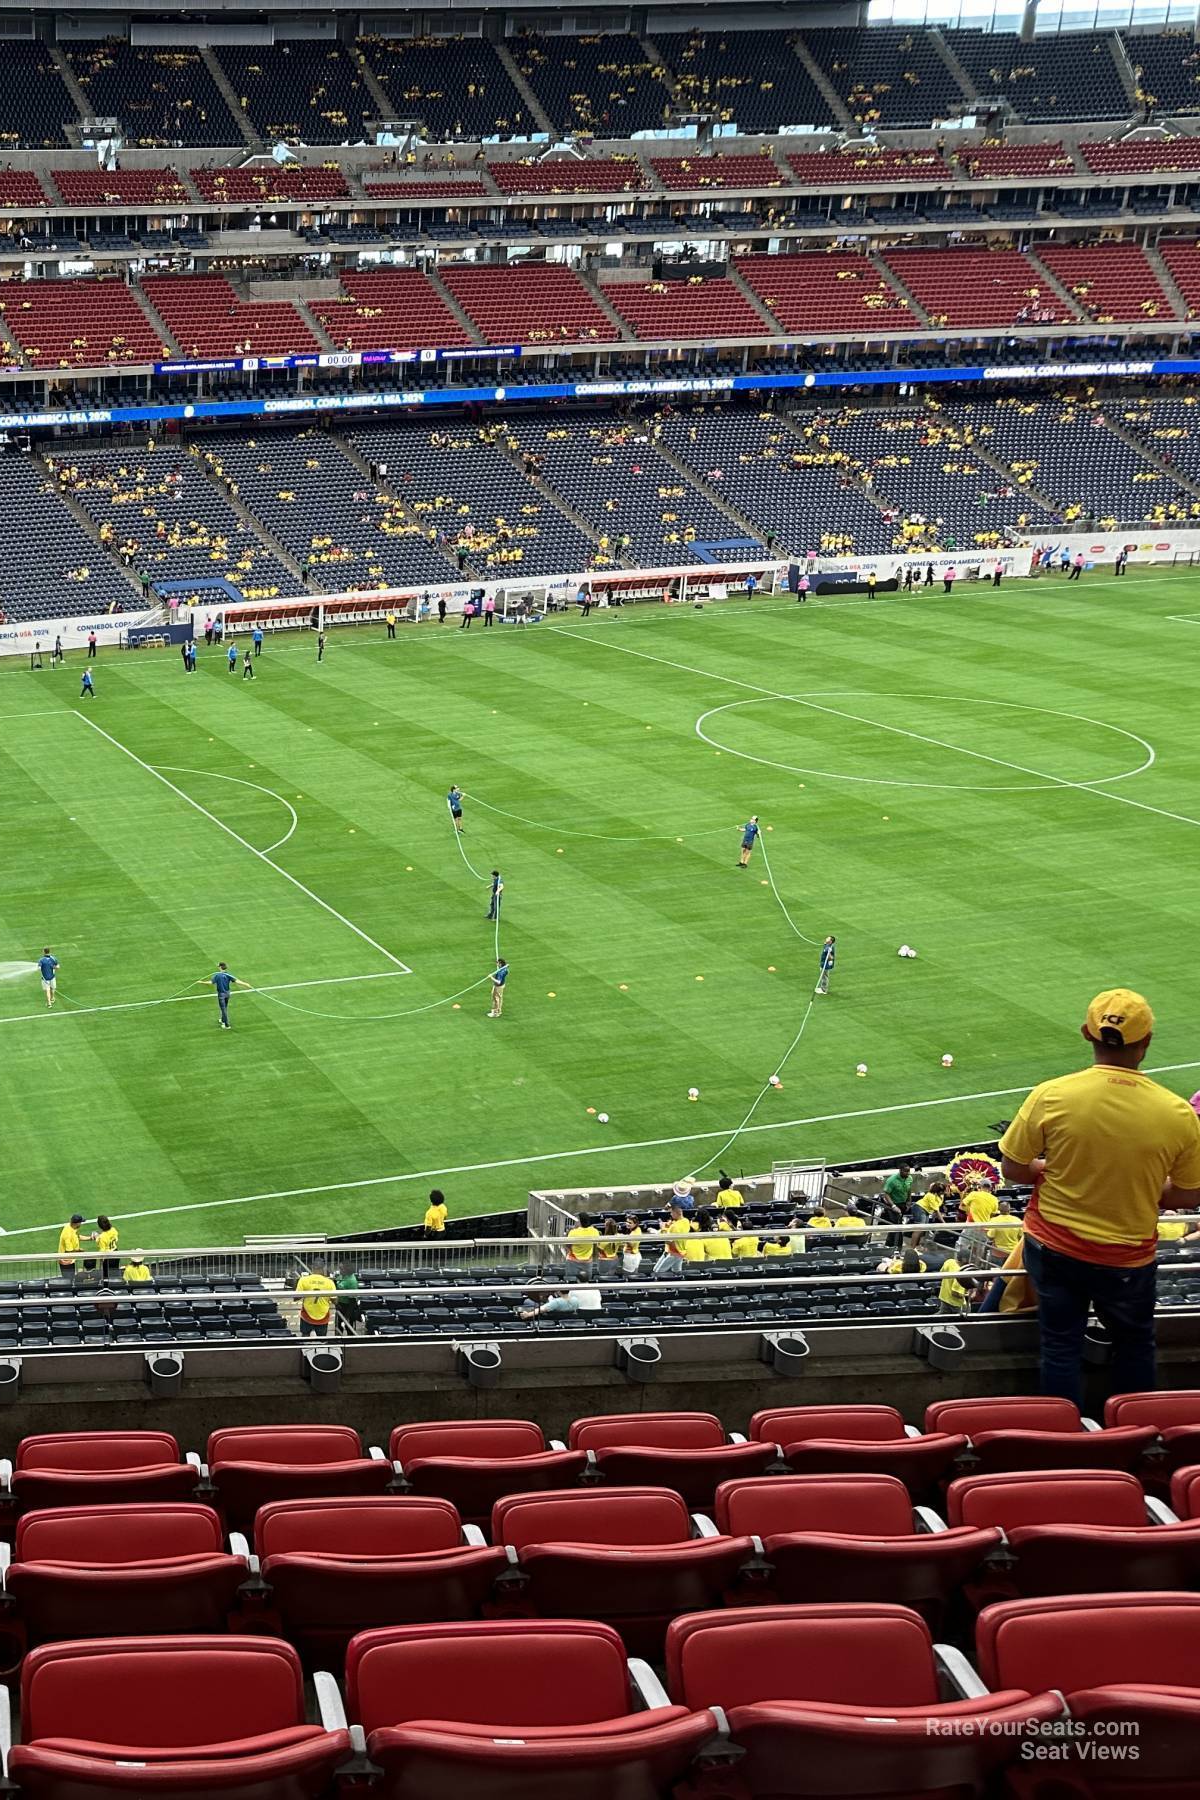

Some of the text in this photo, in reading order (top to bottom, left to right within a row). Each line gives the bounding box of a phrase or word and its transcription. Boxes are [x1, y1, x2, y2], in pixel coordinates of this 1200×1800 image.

[983, 363, 1155, 379] CONMEBOL COPA AMERICA USA 2024
[575, 378, 734, 394] CONMEBOL COPA AMERICA USA 2024
[264, 393, 425, 411] CONMEBOL COPA AMERICA USA 2024
[0, 415, 26, 426] COPA
[25, 413, 69, 424] AMERICA
[69, 412, 88, 423] USA
[88, 411, 112, 421] 2024
[76, 623, 114, 632] CONMEBOL
[1100, 1014, 1126, 1025] FCF
